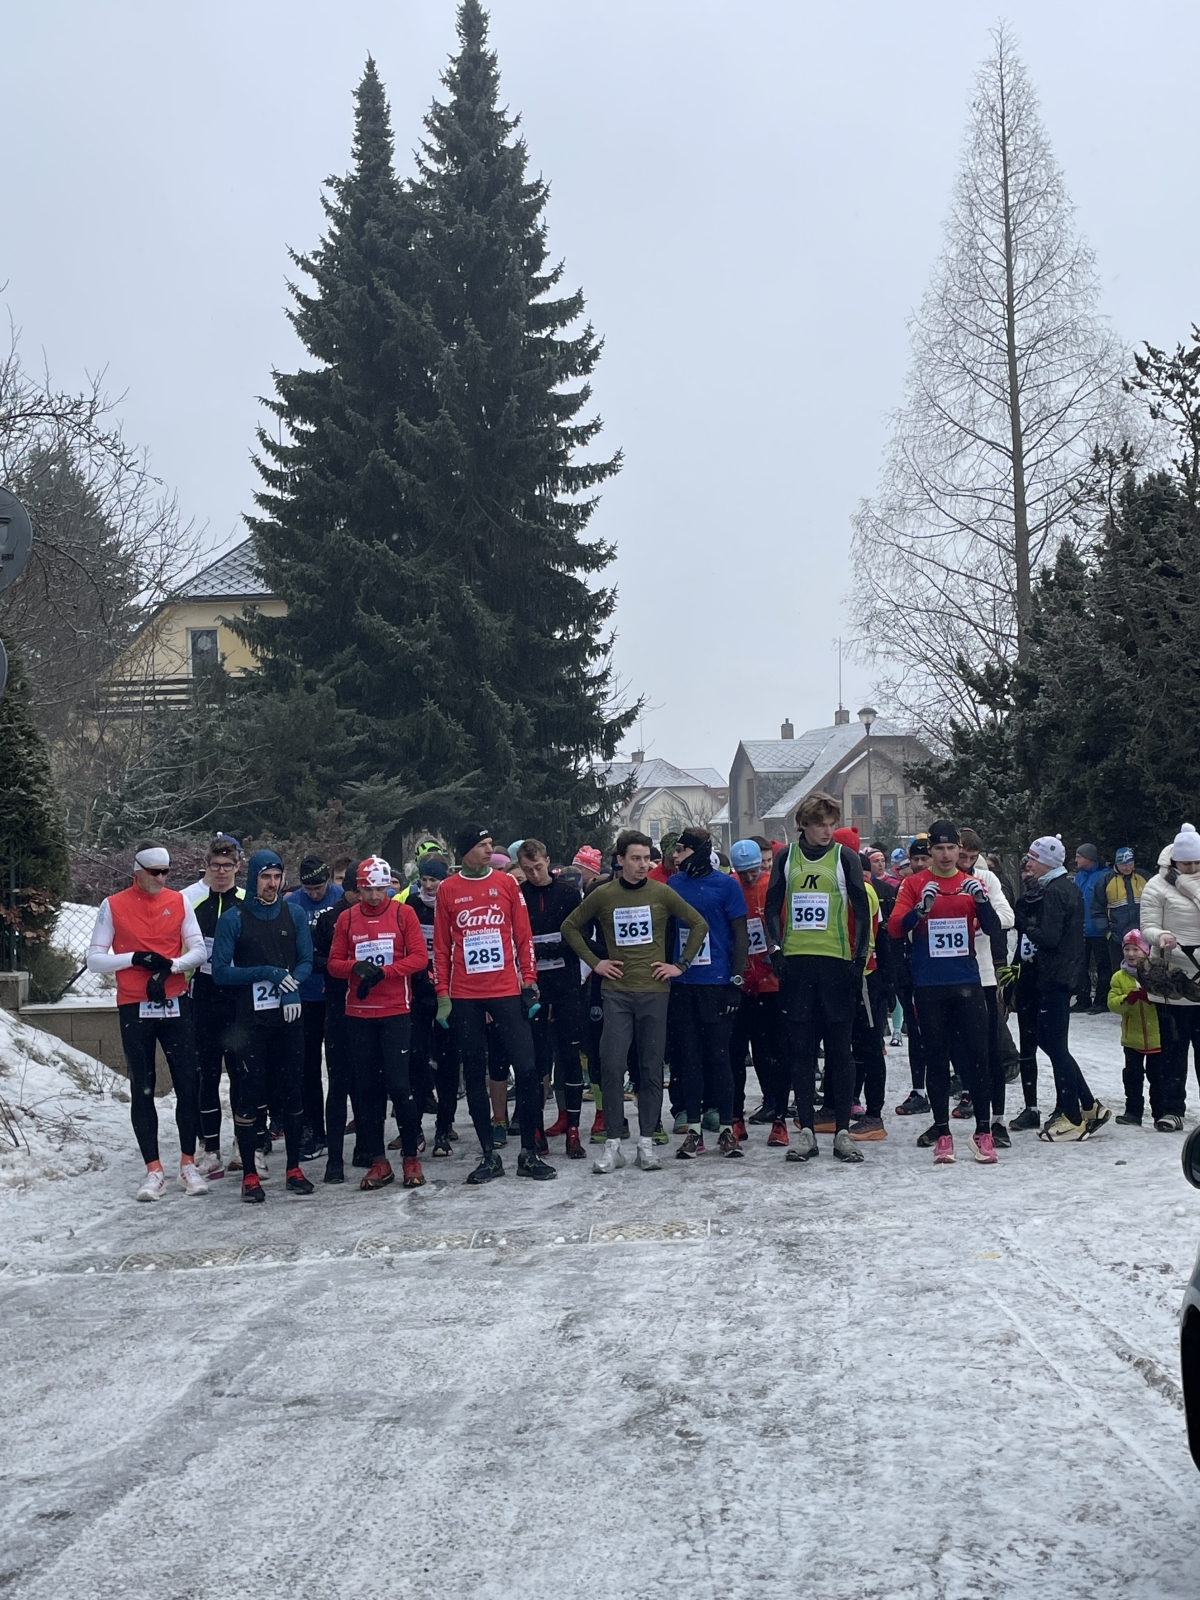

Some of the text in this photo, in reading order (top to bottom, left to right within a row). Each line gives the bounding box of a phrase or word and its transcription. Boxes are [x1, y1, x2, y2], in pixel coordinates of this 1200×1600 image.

[456, 908, 505, 928] Carla
[794, 907, 826, 922] 369
[462, 927, 501, 938] Chocolates
[618, 921, 649, 938] 363
[934, 932, 964, 949] 318
[468, 947, 501, 966] 285
